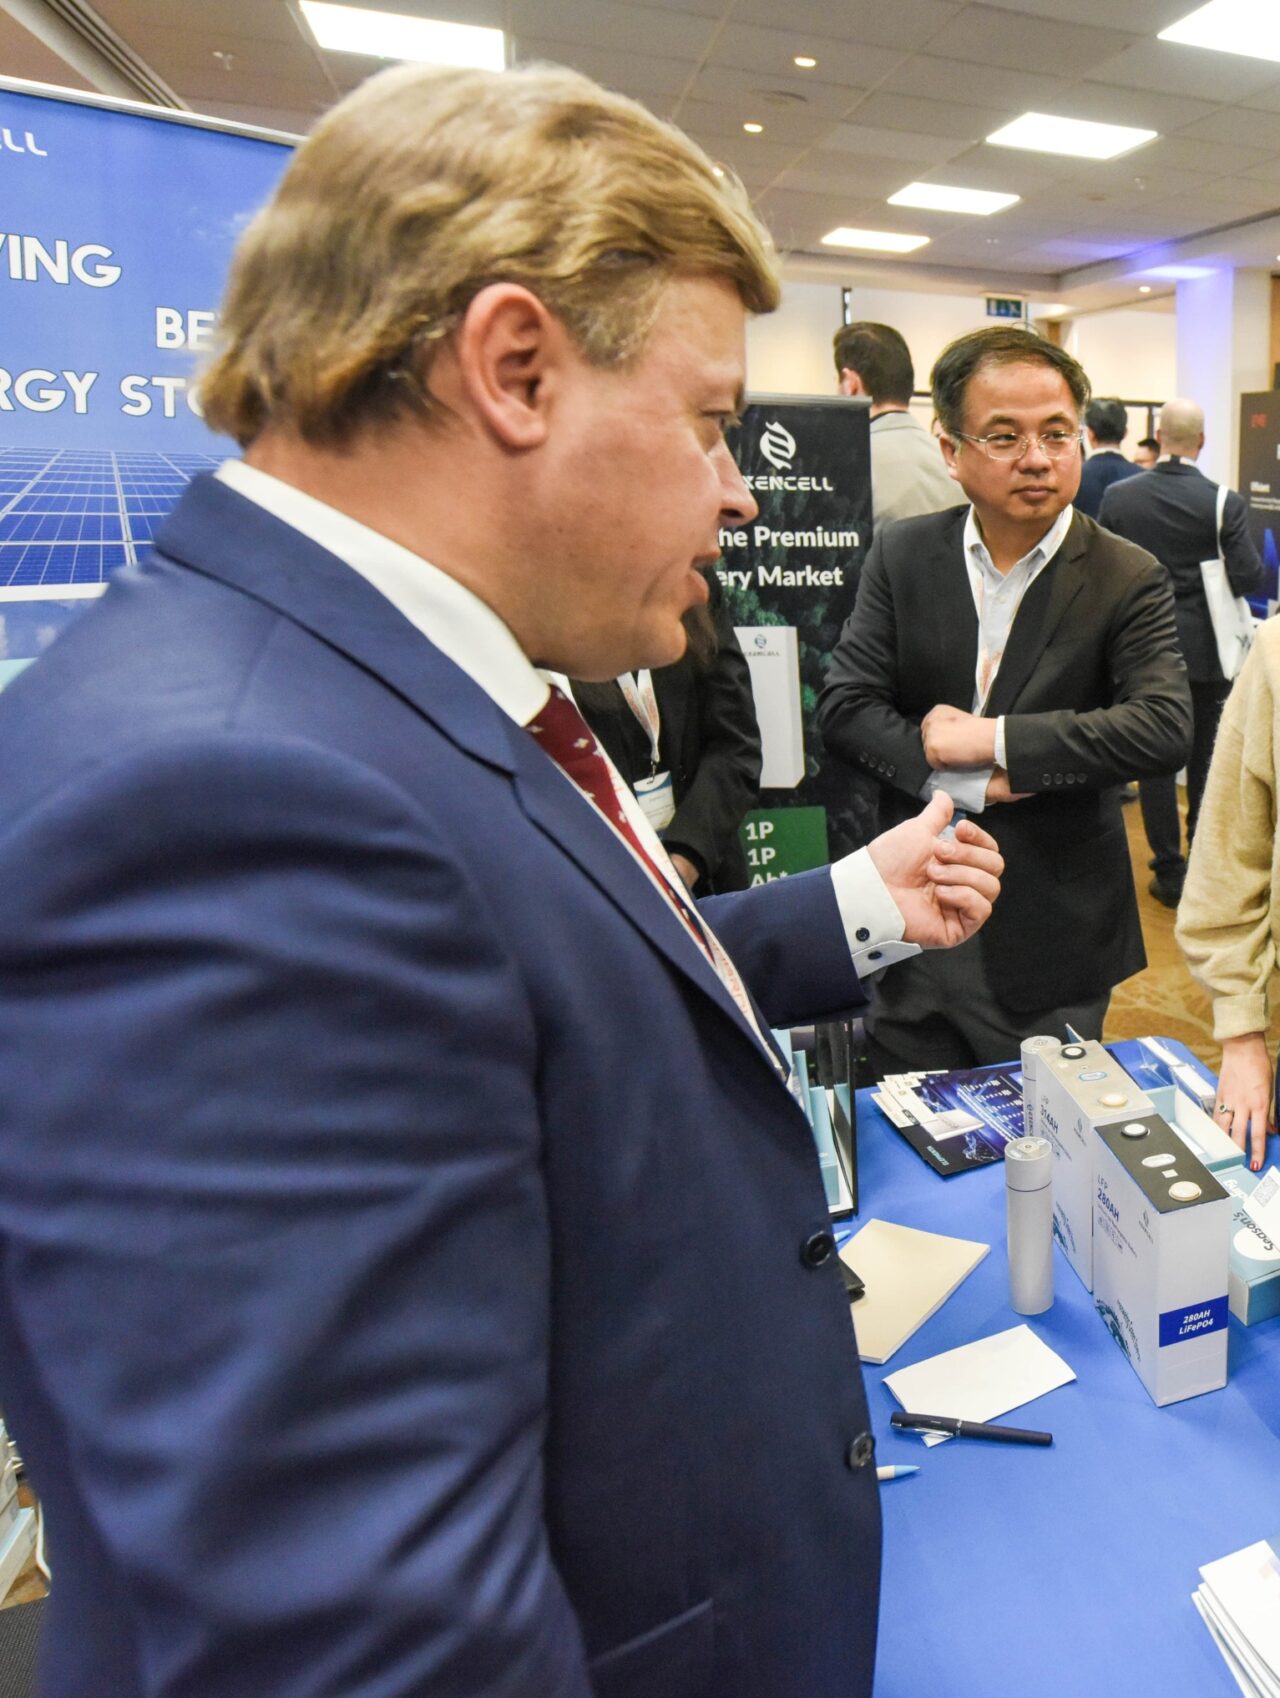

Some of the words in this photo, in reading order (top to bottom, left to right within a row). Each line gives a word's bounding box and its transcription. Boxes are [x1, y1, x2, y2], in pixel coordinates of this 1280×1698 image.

[0, 128, 48, 156] LL
[754, 525, 860, 548] Premium
[757, 565, 844, 588] Market
[745, 821, 775, 840] 1P
[747, 847, 776, 866] 1P
[1097, 1187, 1120, 1222] 280AH
[1178, 1318, 1214, 1335] LiFePO4
[1182, 1309, 1211, 1325] 280AH
